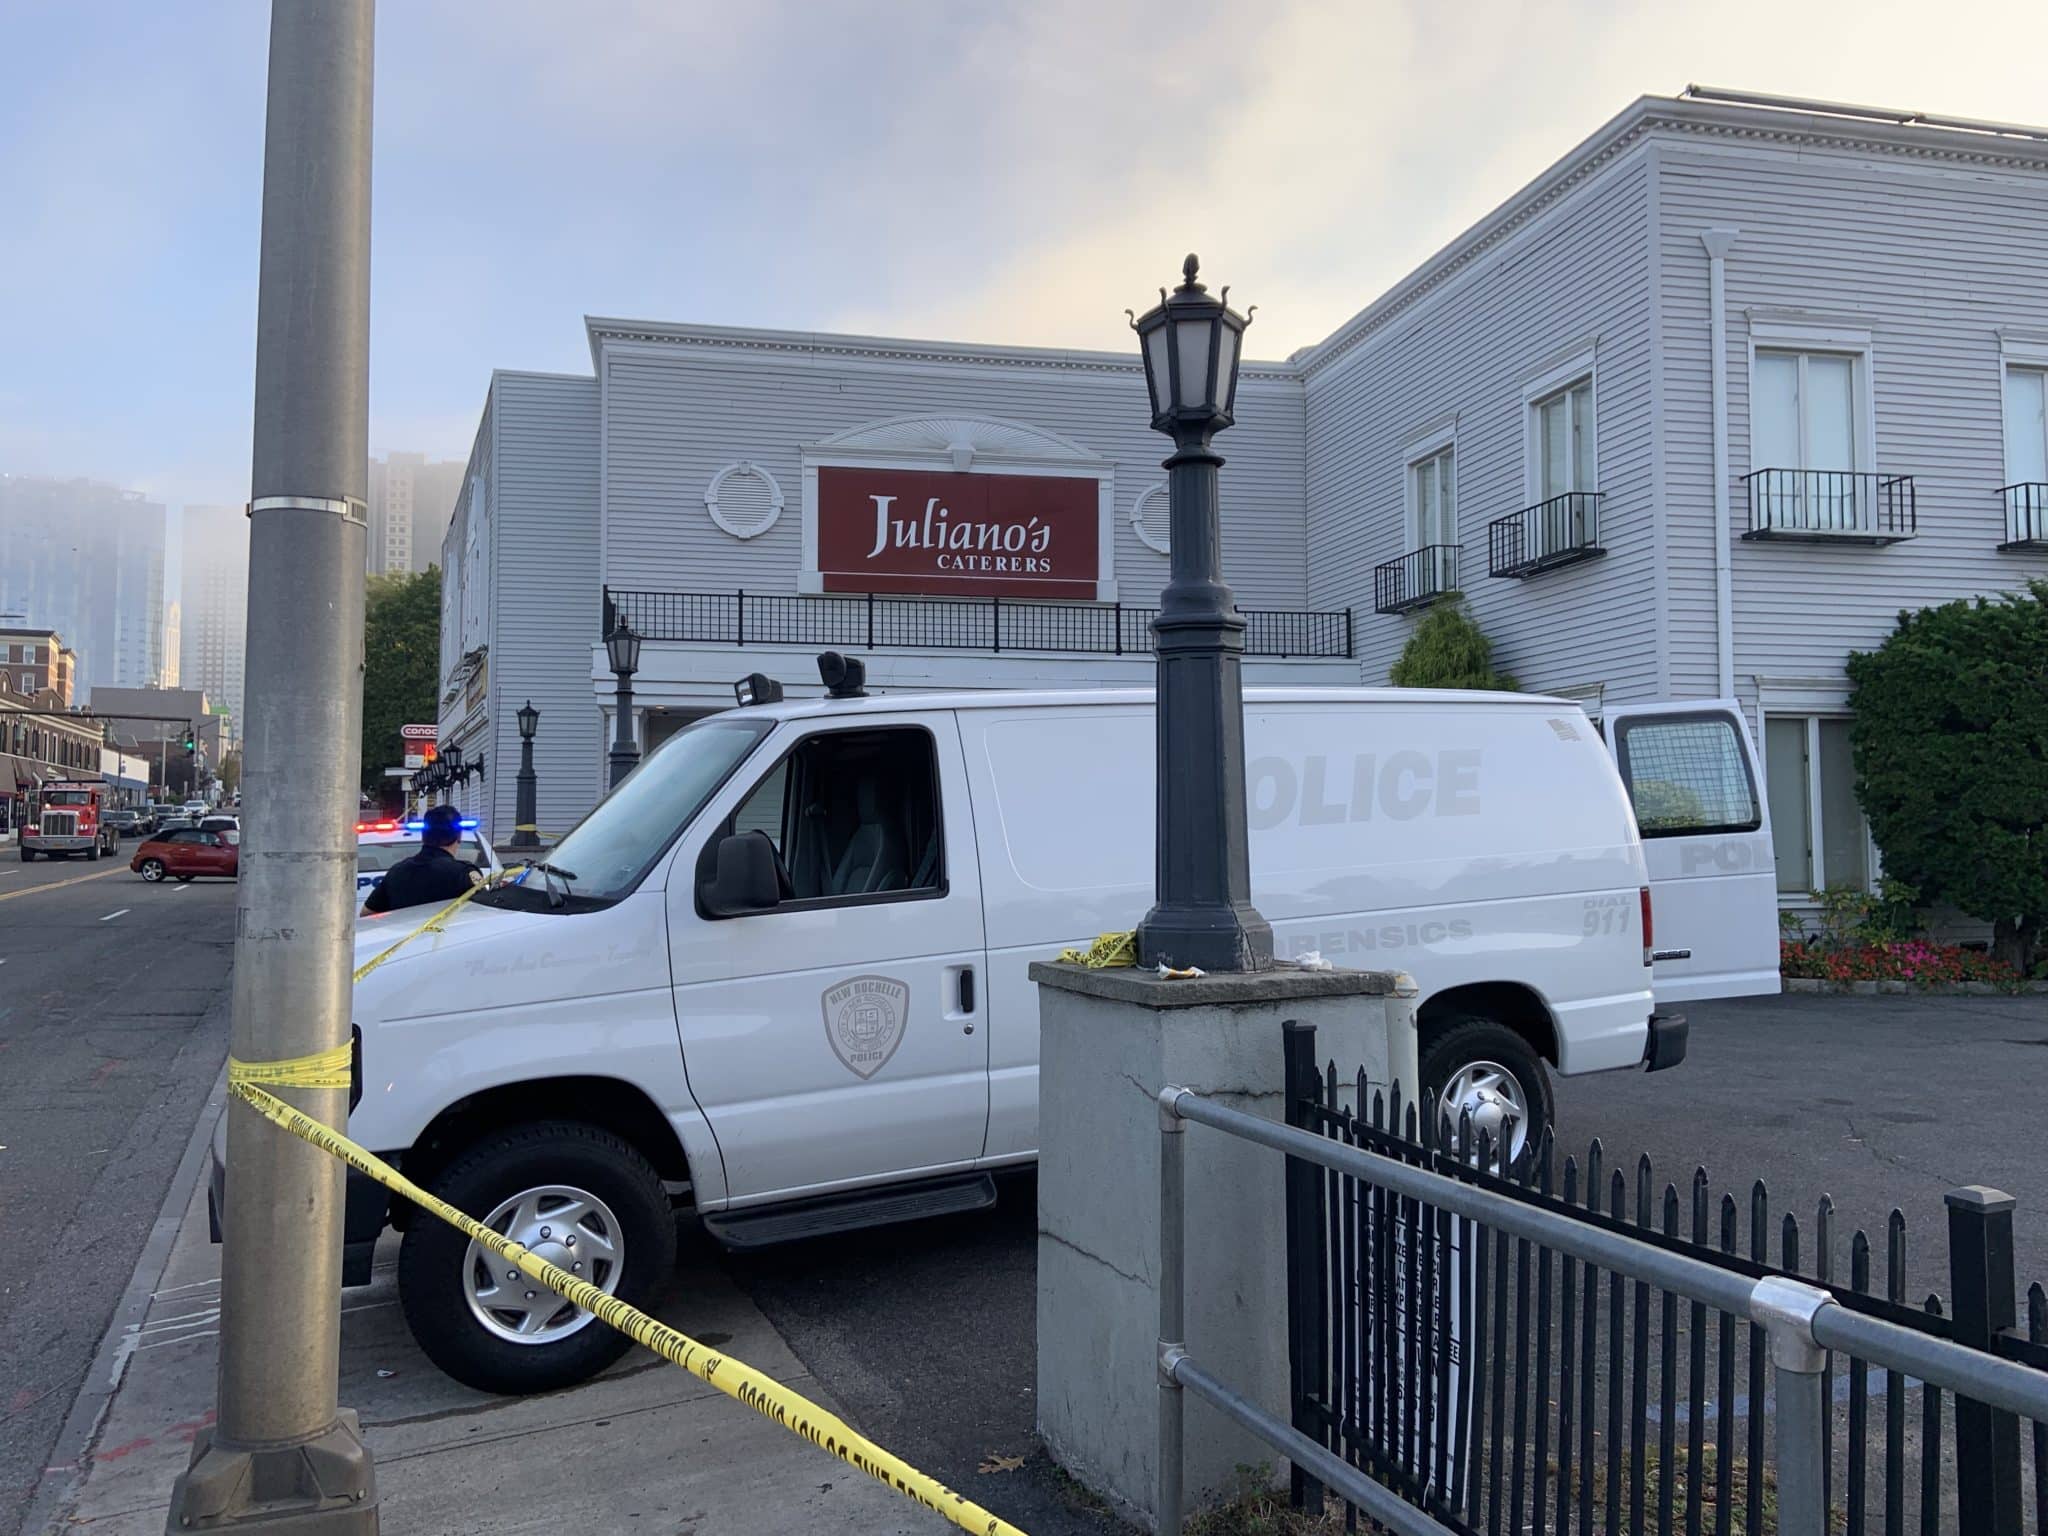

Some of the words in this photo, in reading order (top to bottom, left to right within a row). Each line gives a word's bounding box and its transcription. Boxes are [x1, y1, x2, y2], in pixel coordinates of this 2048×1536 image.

[866, 494, 1051, 558] Juliano's
[936, 554, 1051, 573] CATERERS
[405, 727, 438, 735] conoc
[1247, 748, 1483, 831] OLICE
[1583, 896, 1632, 909] DIAL
[1583, 905, 1632, 937] 911
[1273, 918, 1474, 959] RENSICS
